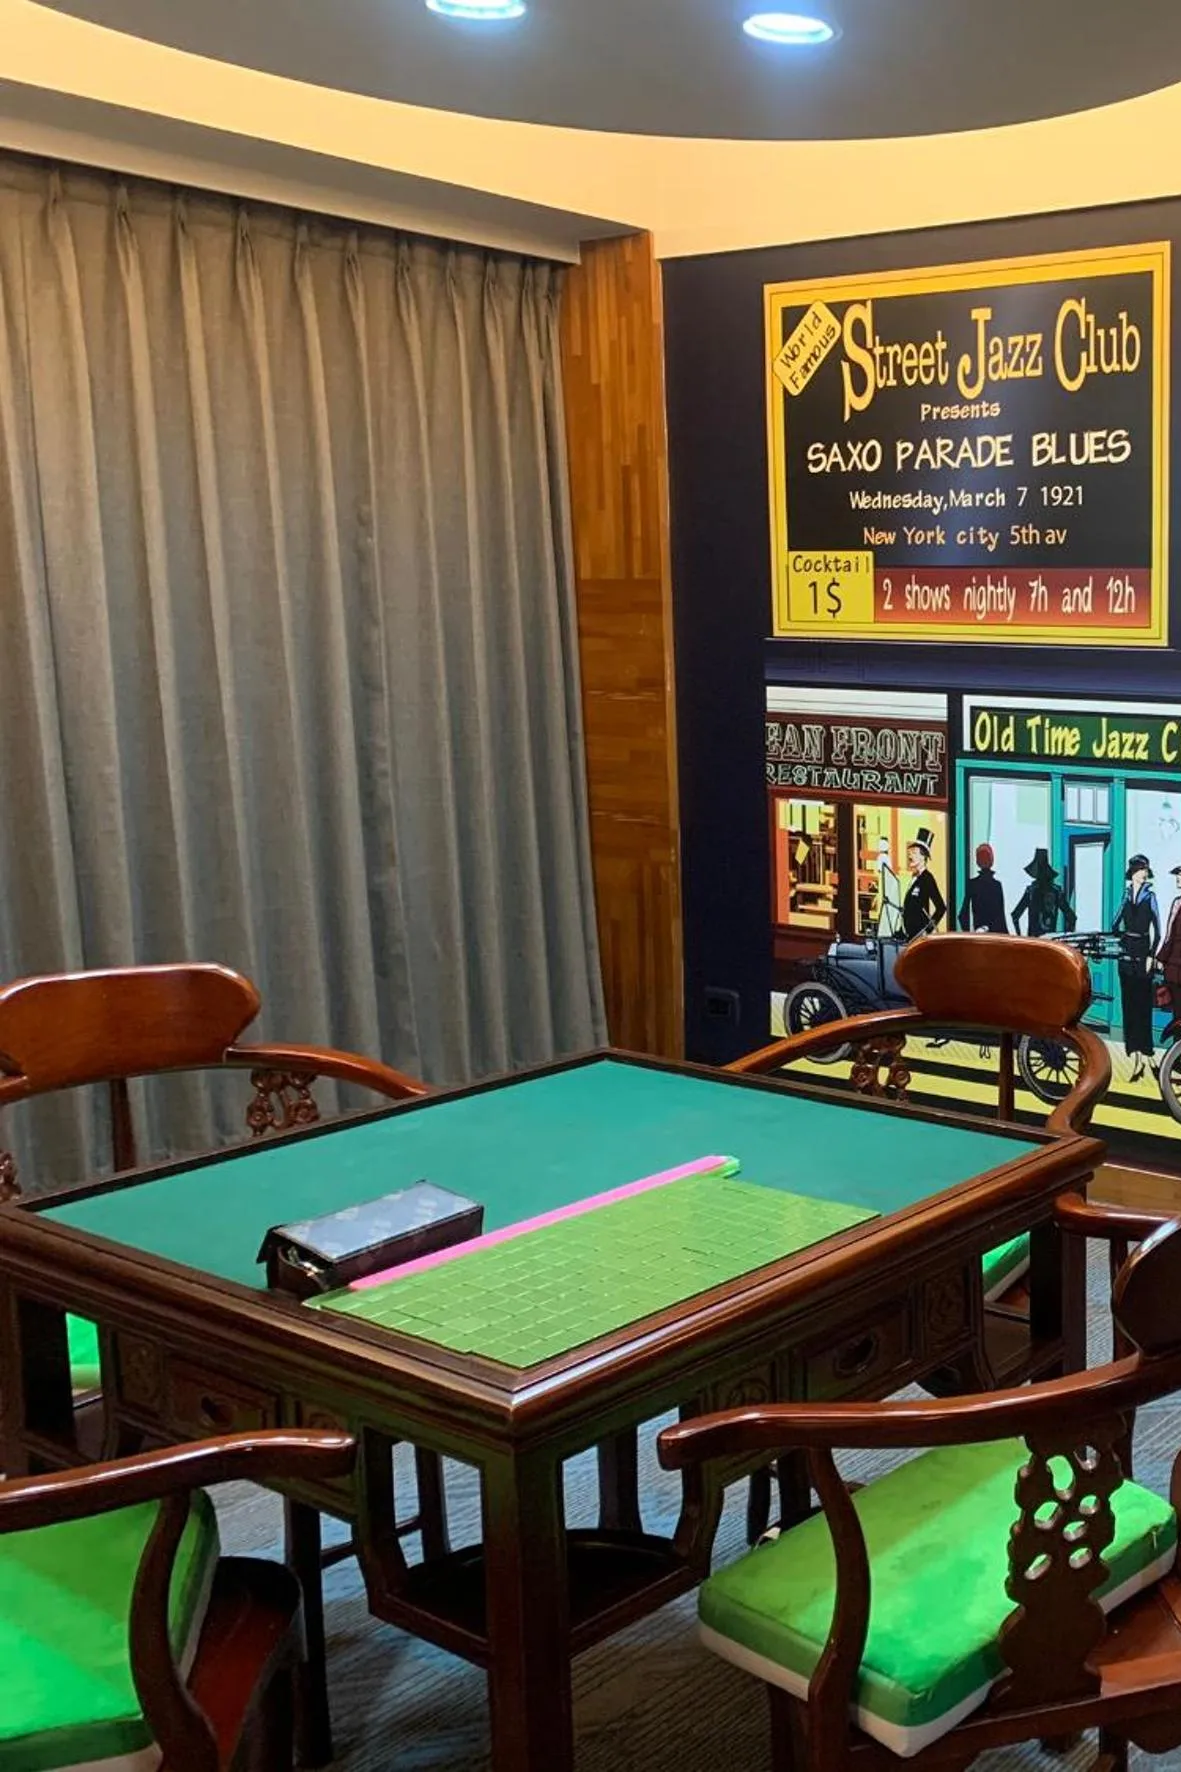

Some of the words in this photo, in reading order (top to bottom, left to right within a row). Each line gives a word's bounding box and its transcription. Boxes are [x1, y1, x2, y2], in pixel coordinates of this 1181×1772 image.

[780, 311, 822, 368] World
[789, 324, 836, 390] Famous
[841, 299, 949, 424] Street
[956, 307, 1043, 399] Jazz
[1054, 298, 1141, 391] Club
[920, 401, 1000, 422] Presents
[807, 439, 883, 474] SAXO
[896, 434, 1014, 471] PARADE
[1031, 429, 1131, 467] BLUES
[1016, 487, 1027, 507] 7
[1041, 485, 1084, 507] 1921
[863, 526, 896, 544] New
[903, 524, 946, 546] York
[956, 528, 999, 552] city
[1009, 524, 1040, 545] 5th
[1044, 527, 1067, 545] av
[792, 554, 870, 574] Cocktail
[883, 579, 893, 611] 2
[905, 575, 950, 611] shows
[963, 575, 1016, 621] nightly
[1029, 578, 1048, 612] 7h
[1062, 578, 1092, 613] and
[1106, 576, 1135, 614] 12h
[831, 725, 946, 772] FRONT
[974, 712, 1015, 753] Old
[1027, 715, 1079, 758] Time
[1092, 717, 1149, 761] Jazz
